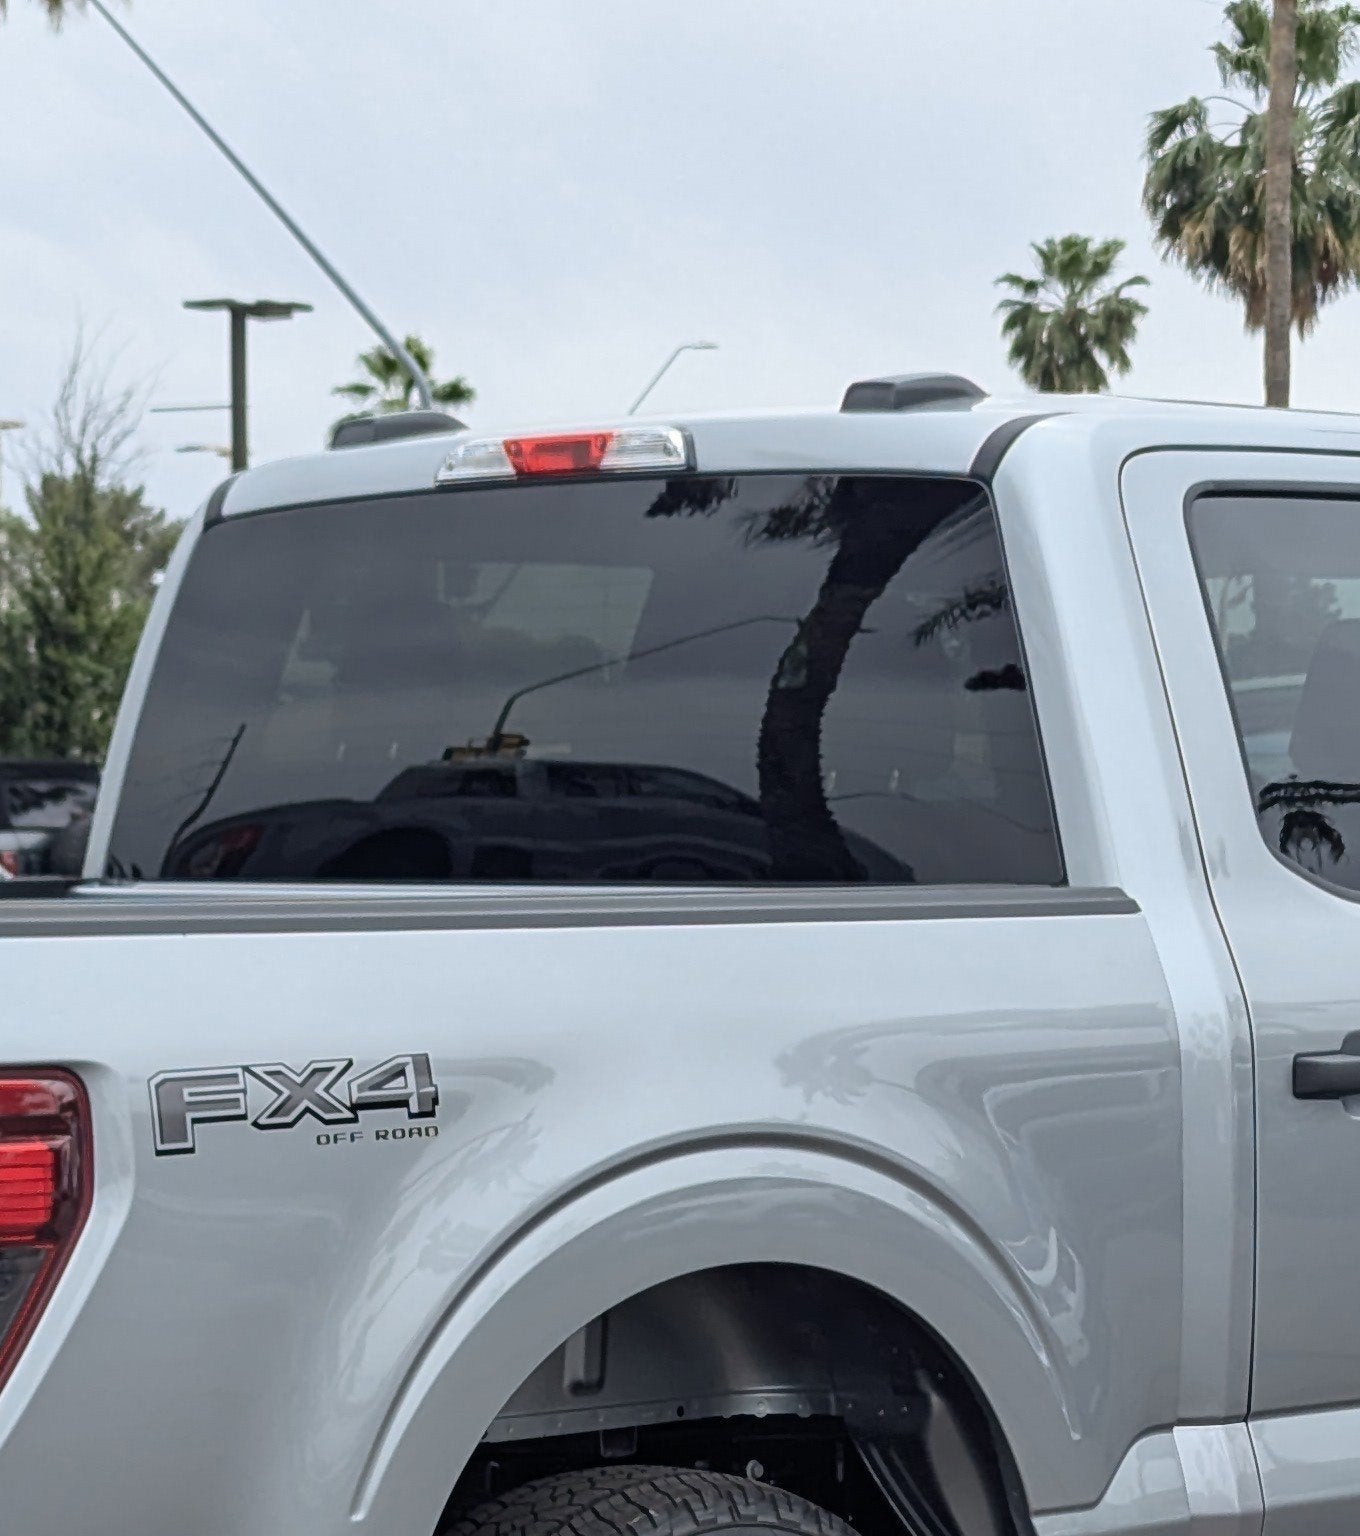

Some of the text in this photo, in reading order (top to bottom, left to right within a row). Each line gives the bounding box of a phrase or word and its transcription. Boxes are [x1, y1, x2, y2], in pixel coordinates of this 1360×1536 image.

[147, 1053, 440, 1156] FX4
[316, 1125, 439, 1146] OFF ROAD
